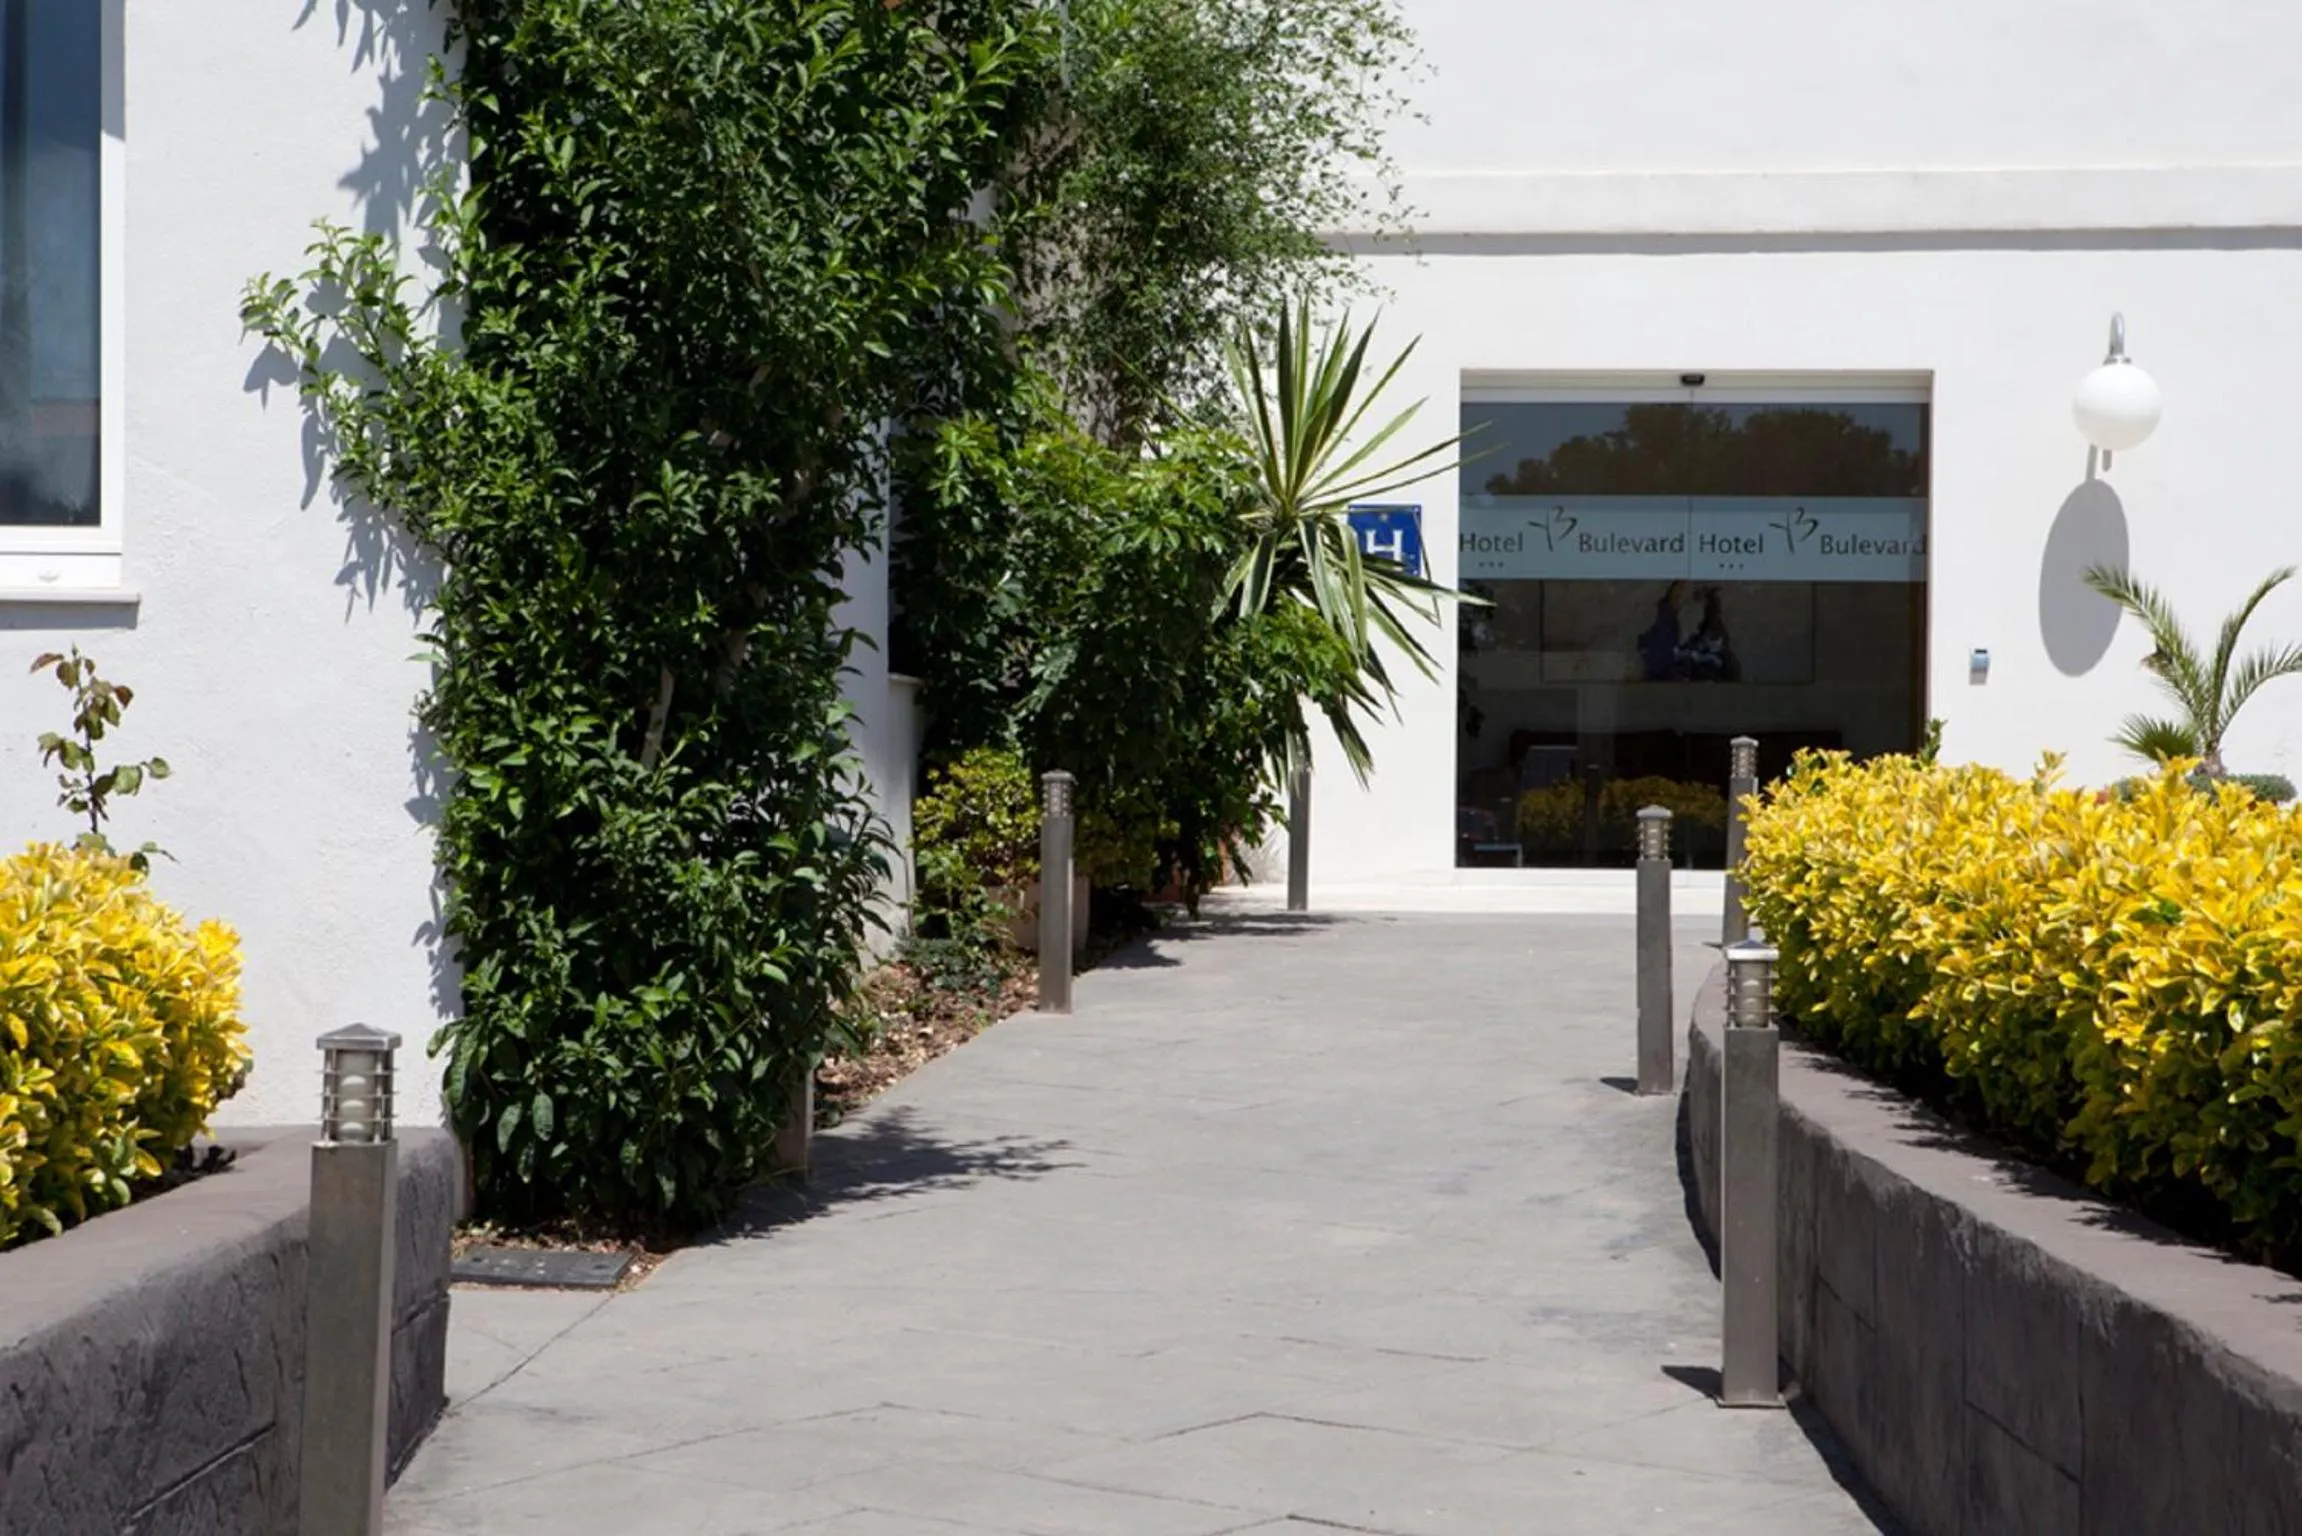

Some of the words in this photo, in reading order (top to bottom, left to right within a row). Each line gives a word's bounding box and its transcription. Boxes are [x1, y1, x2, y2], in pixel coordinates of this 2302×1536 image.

[1365, 529, 1403, 572] H
[1459, 532, 1523, 553] Hotel
[1578, 532, 1686, 553] Bulevard
[1699, 533, 1764, 555] Hotel
[1819, 534, 1927, 556] Bulevard
